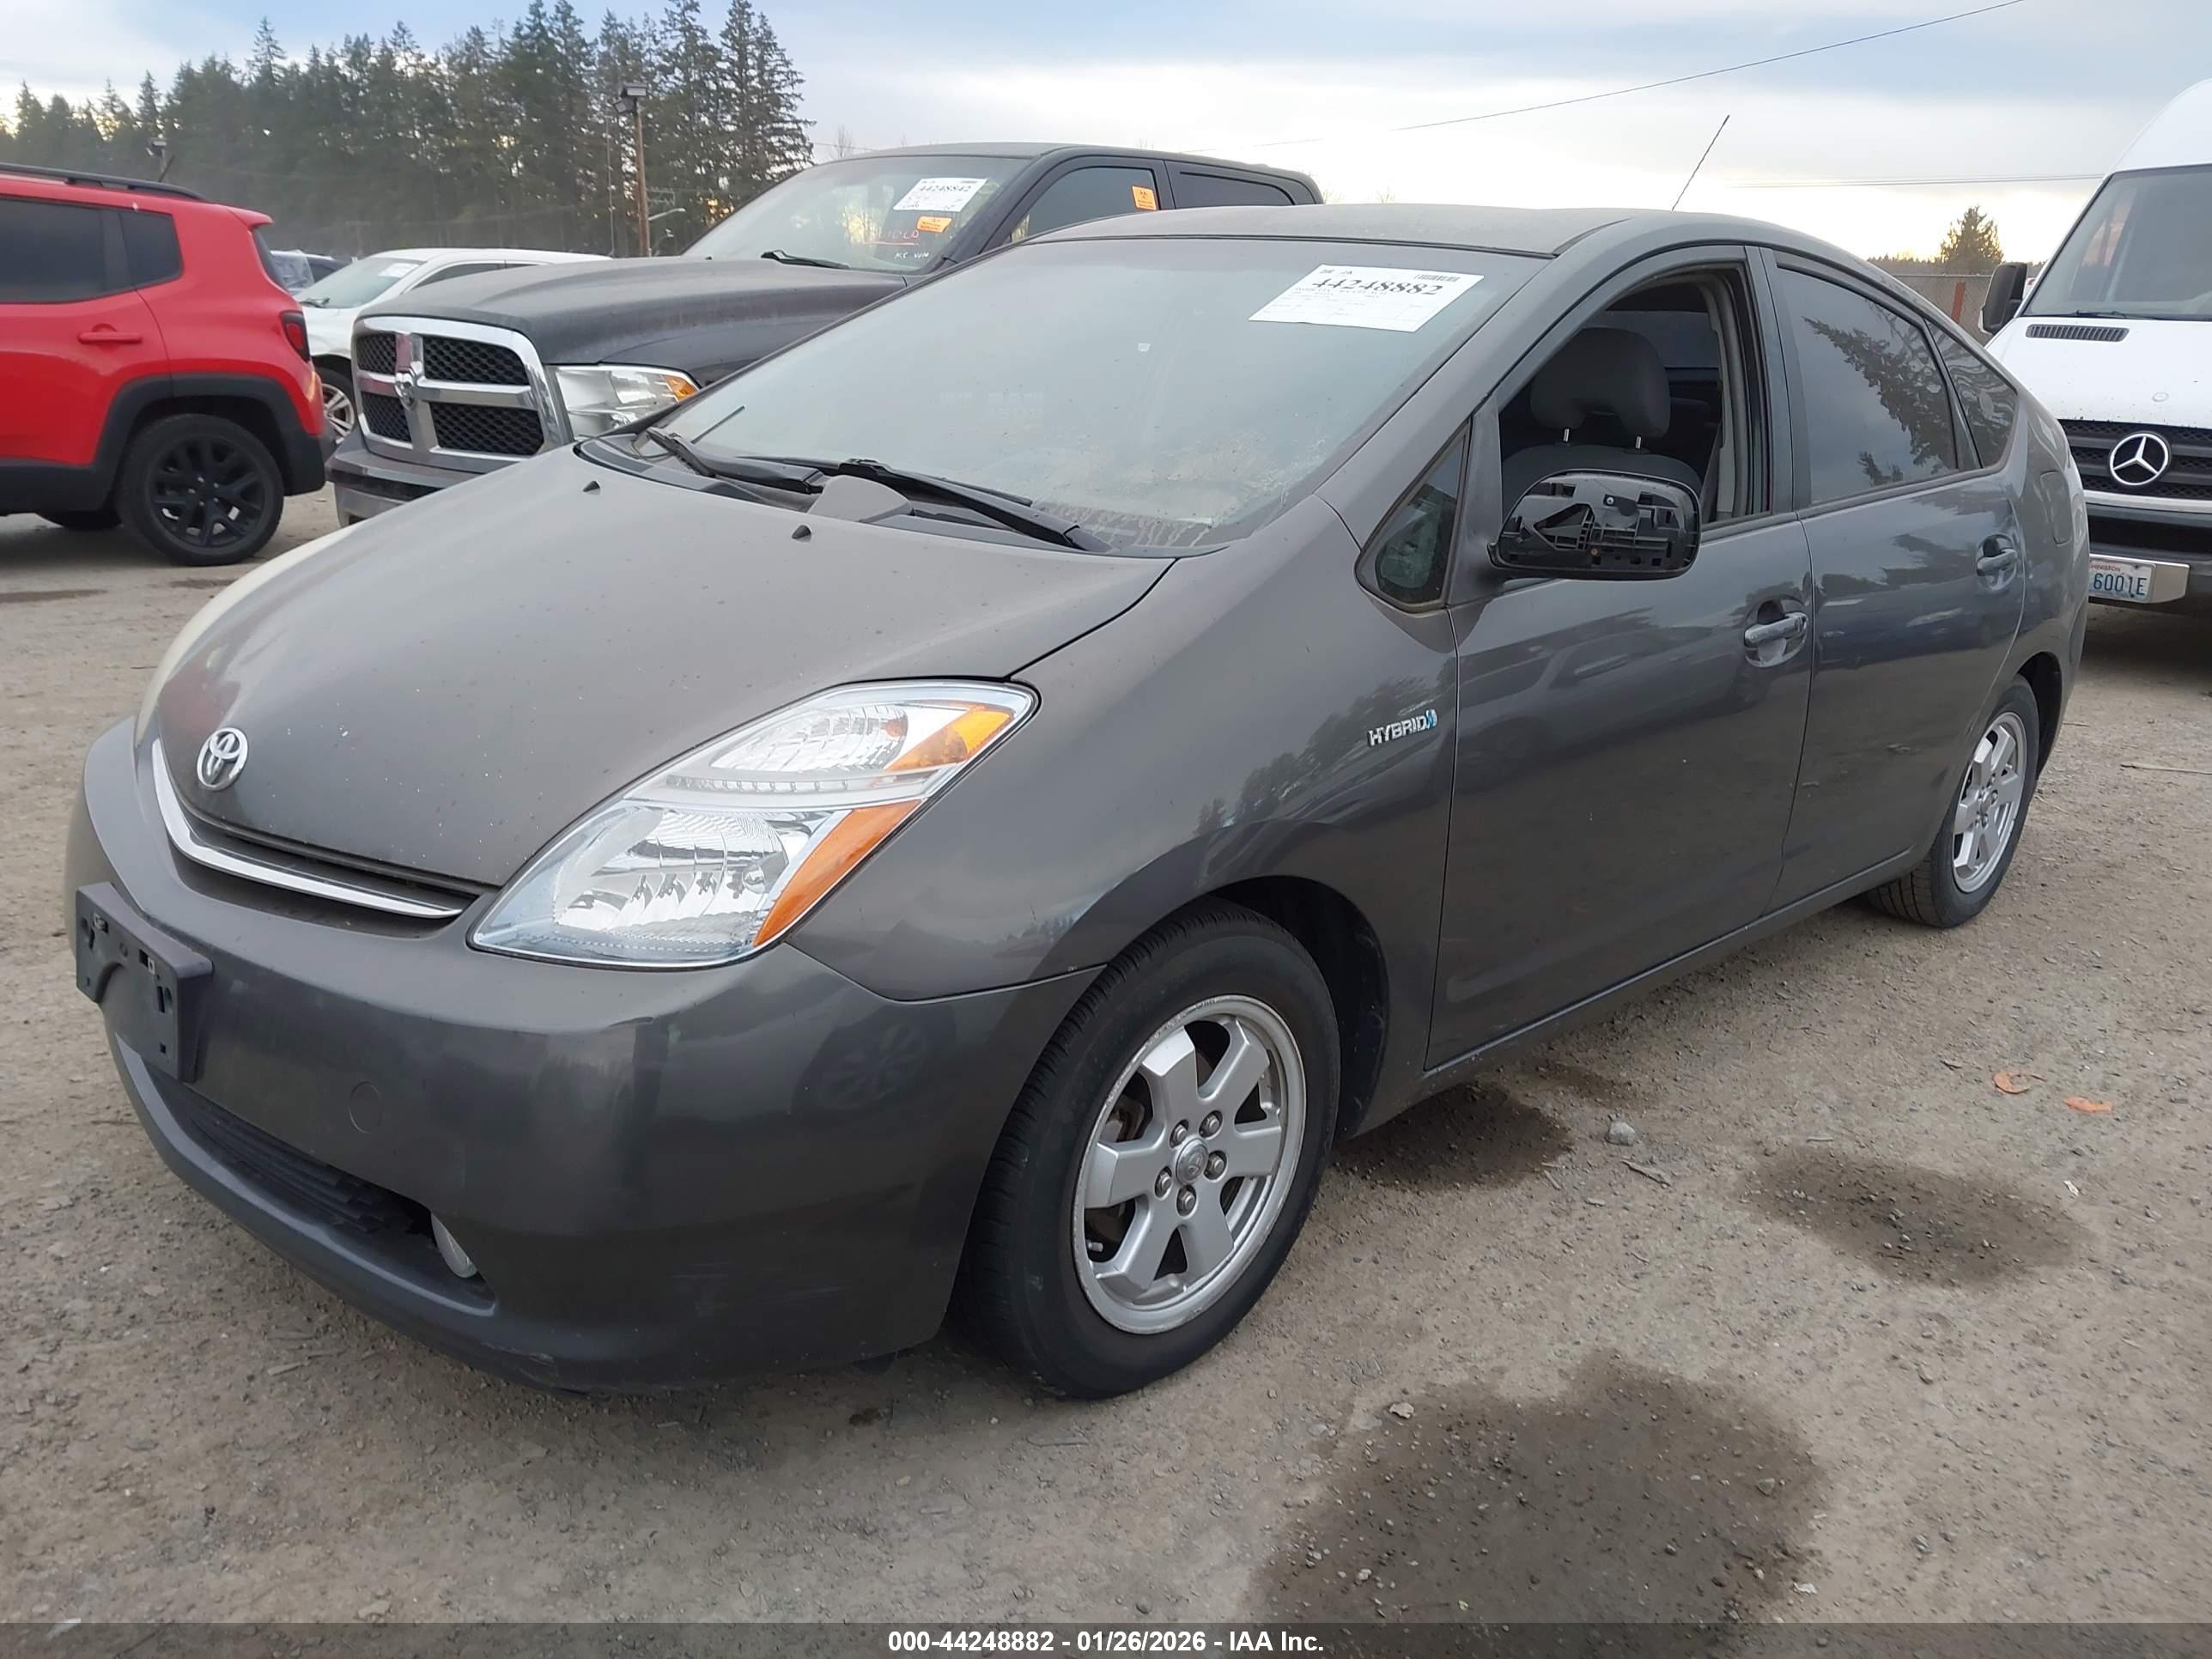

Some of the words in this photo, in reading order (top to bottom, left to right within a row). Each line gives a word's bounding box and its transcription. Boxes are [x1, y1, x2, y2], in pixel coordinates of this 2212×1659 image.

[1312, 278, 1443, 295] 44248882
[2094, 573, 2147, 595] 6001E
[1368, 714, 1429, 746] HYBRID
